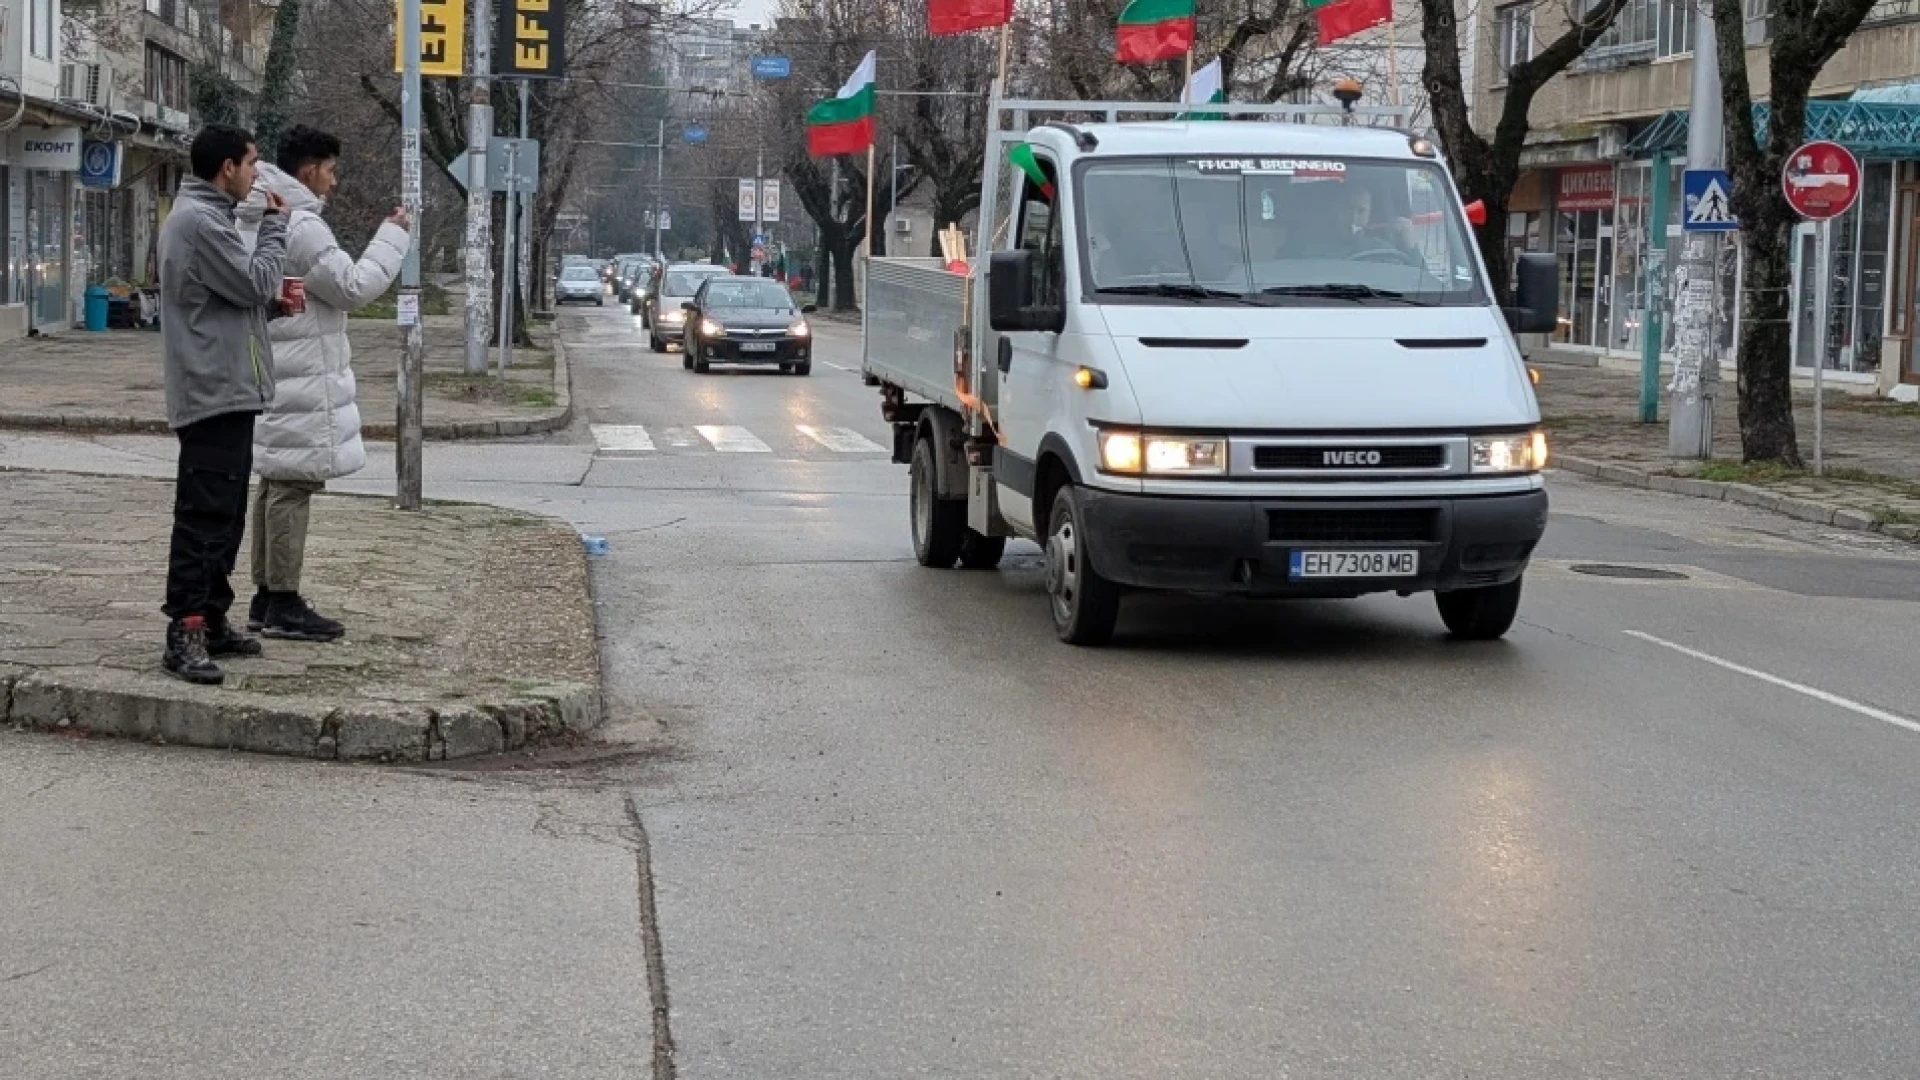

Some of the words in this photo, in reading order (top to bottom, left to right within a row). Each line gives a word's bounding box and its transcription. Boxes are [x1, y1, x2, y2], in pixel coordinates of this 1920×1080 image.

[421, 0, 446, 62] EF
[24, 140, 74, 153] ЕКОНТ
[1260, 159, 1346, 171] BRENNERO
[1322, 451, 1381, 464] IVECO
[1304, 553, 1332, 573] EH
[1335, 553, 1384, 573] 7308
[1387, 553, 1414, 573] MB
